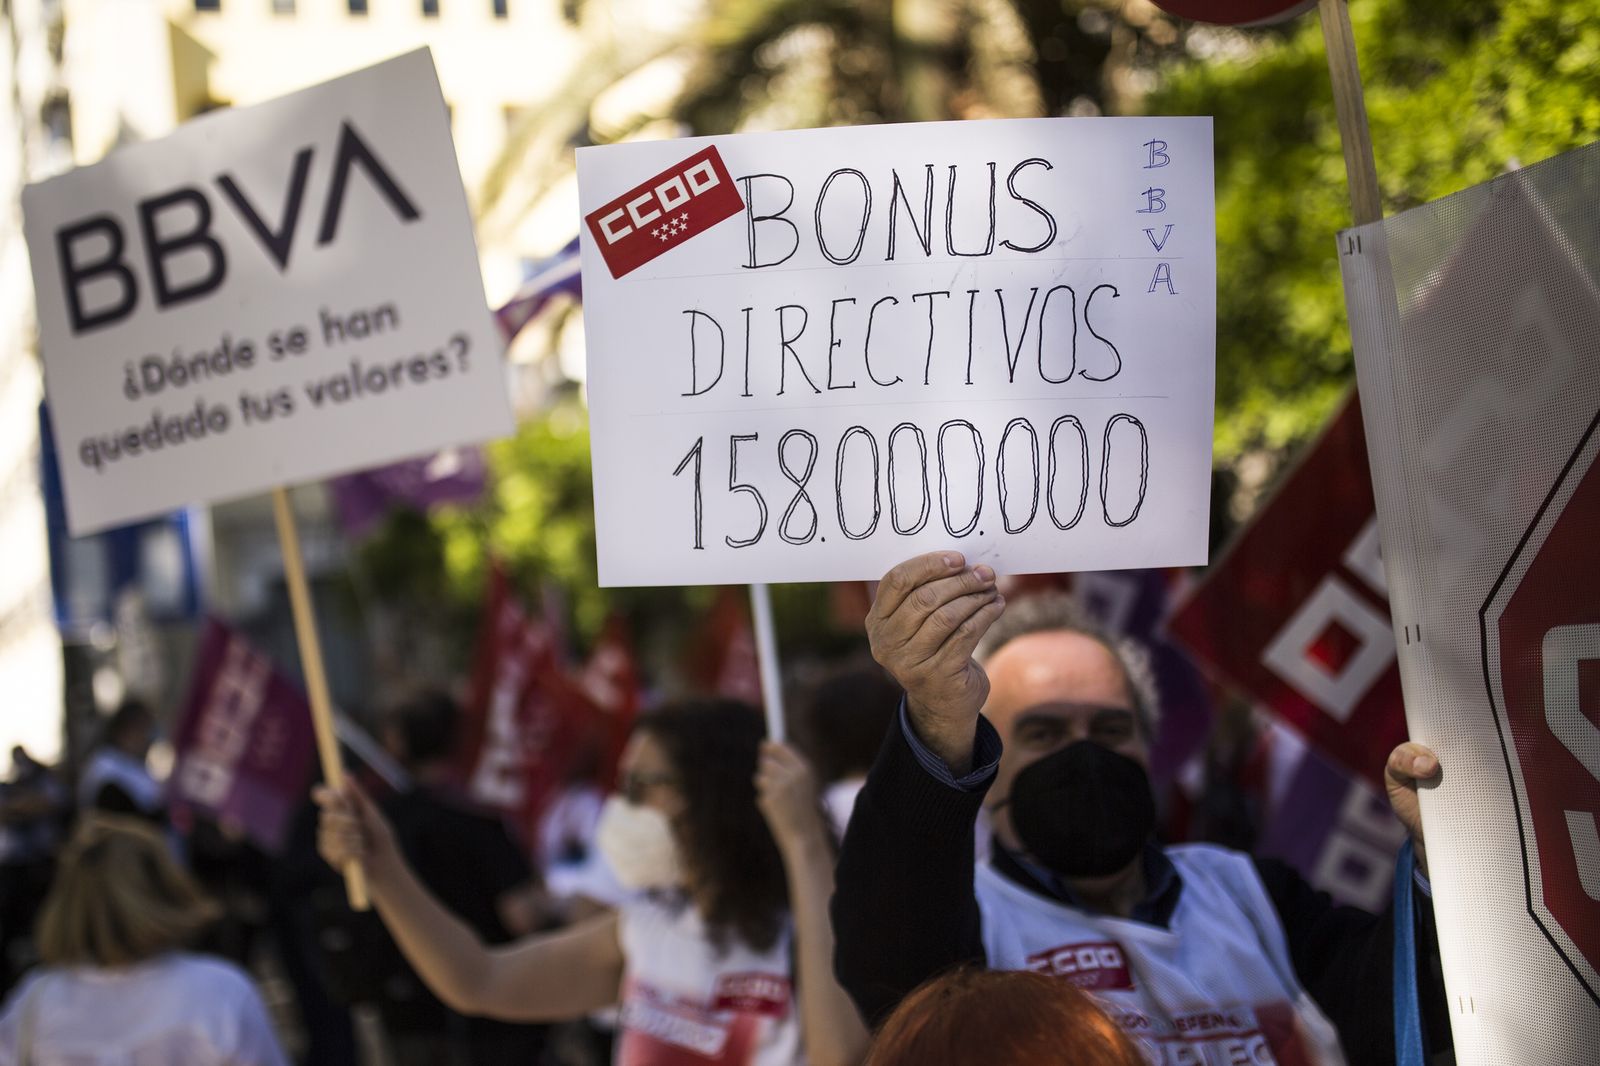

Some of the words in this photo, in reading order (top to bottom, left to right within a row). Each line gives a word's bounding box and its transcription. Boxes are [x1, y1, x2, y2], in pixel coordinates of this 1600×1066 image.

[54, 121, 421, 338] BBVA
[598, 158, 721, 246] CCOO
[736, 157, 1058, 269] BONUS
[122, 335, 257, 402] ¿Dónde
[267, 327, 310, 361] se
[319, 304, 399, 345] han
[681, 283, 1122, 397] DIRECTIVOS
[77, 404, 231, 474] quedado
[238, 389, 295, 425] tus
[305, 334, 470, 407] valores?
[672, 412, 1149, 550] 158.000.000
